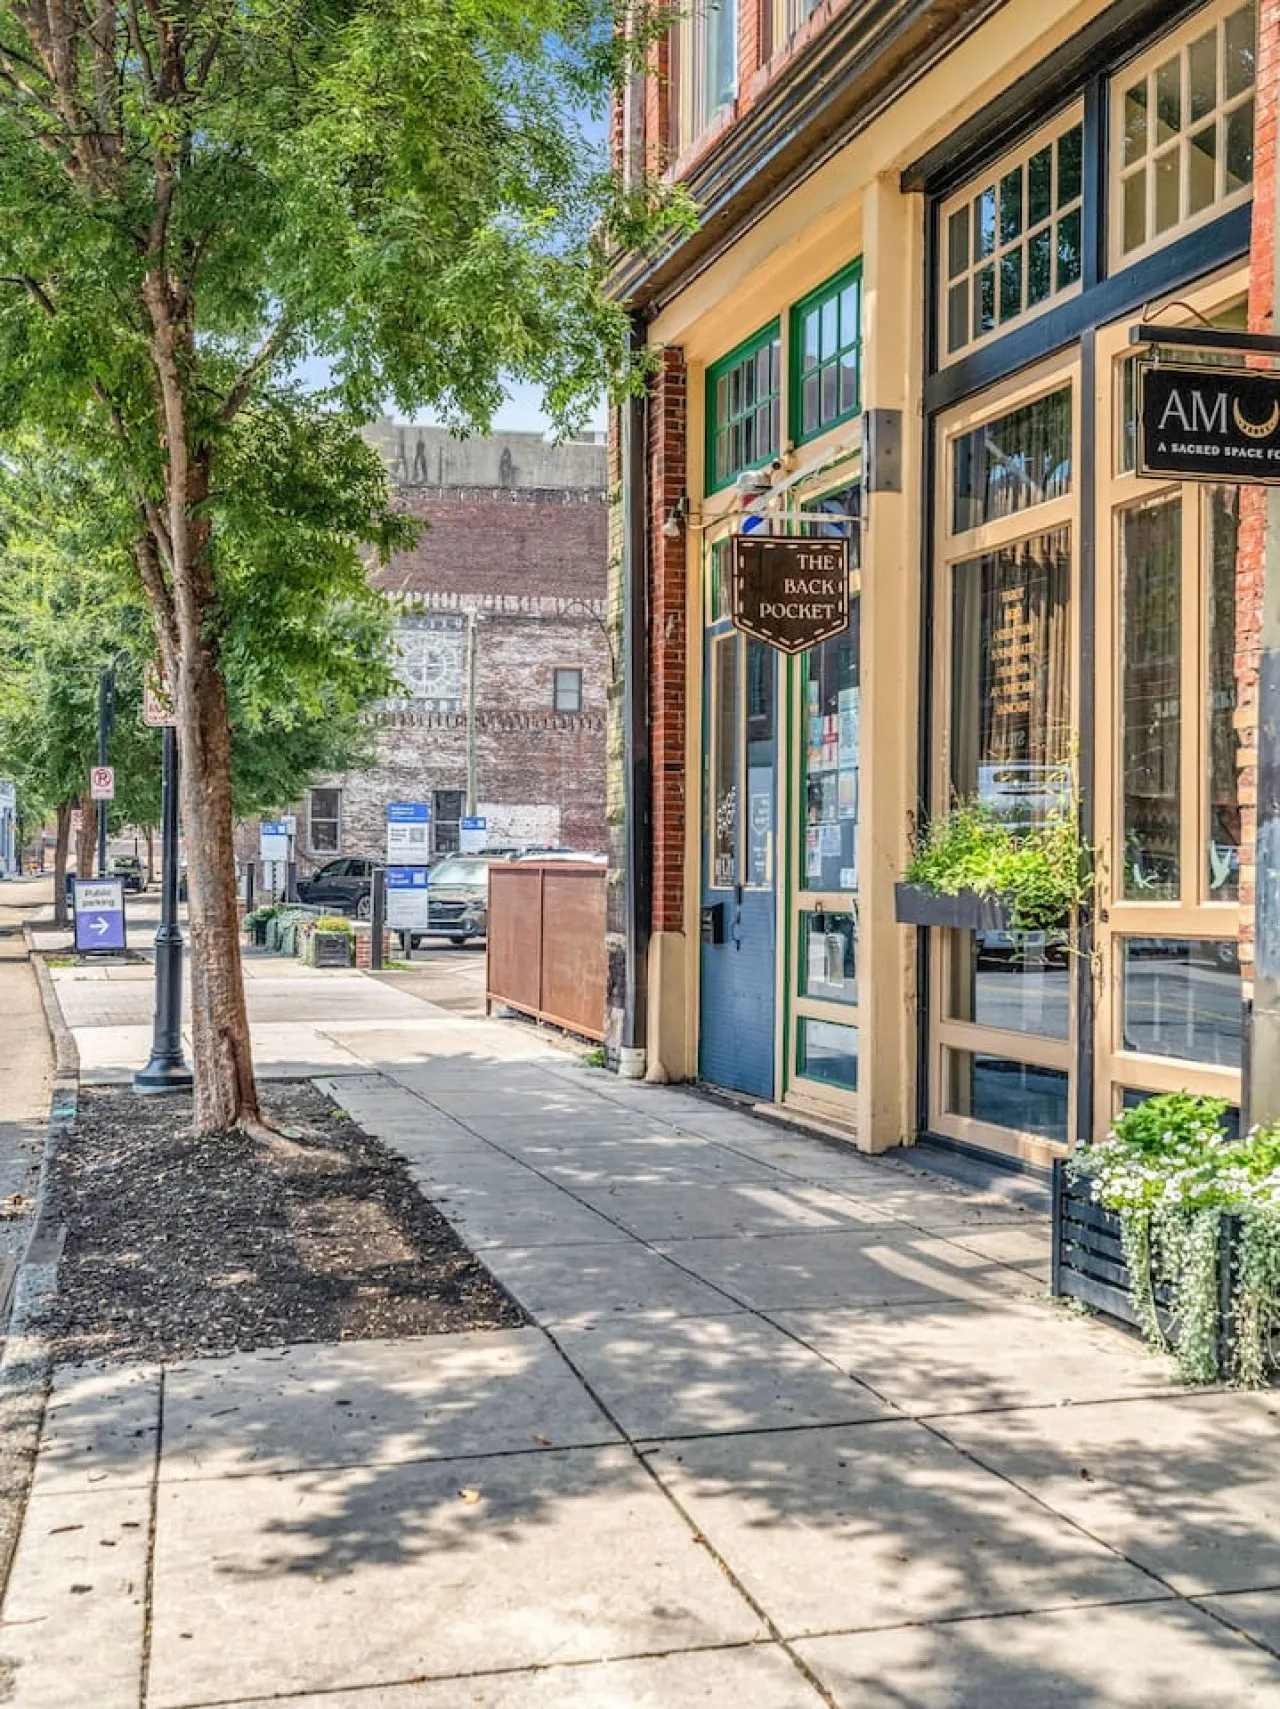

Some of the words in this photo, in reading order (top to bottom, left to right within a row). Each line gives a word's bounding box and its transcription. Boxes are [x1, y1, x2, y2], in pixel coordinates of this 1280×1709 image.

[1158, 442, 1167, 452] A
[1171, 442, 1221, 456] SACRED
[1224, 446, 1264, 459] SPACE
[797, 553, 835, 571] THE
[784, 578, 835, 595] BACK
[760, 603, 836, 619] POCKET
[82, 899, 115, 909] parking
